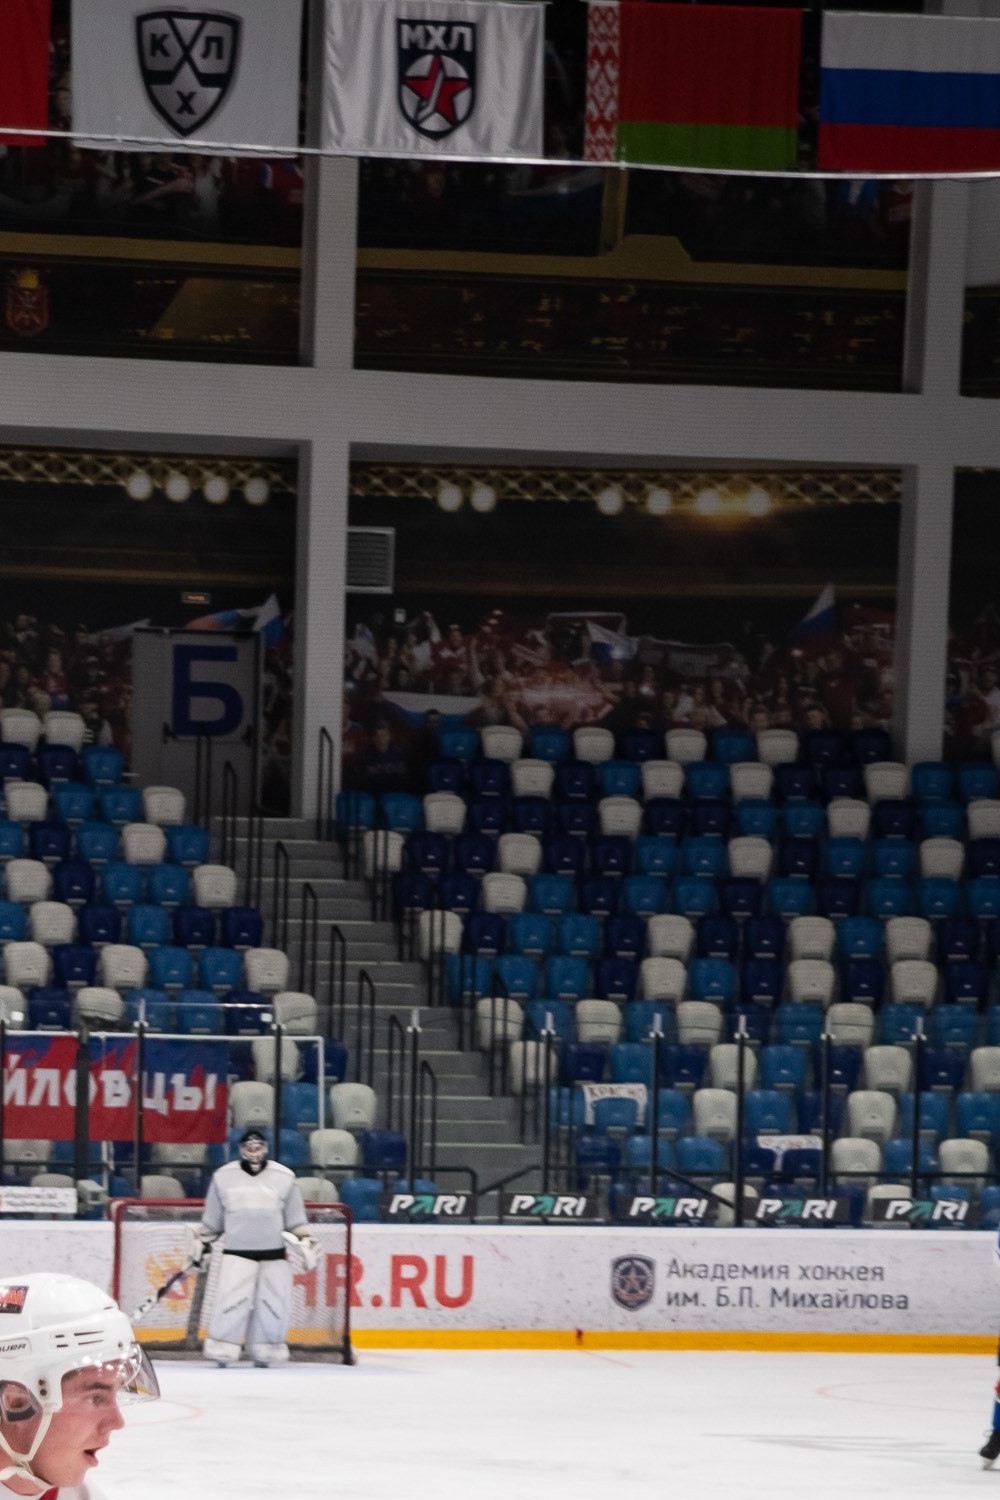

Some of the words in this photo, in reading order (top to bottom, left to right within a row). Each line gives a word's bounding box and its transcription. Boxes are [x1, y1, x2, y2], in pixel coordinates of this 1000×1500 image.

[400, 24, 473, 52] МХЛ
[173, 645, 244, 736] Б
[389, 1194, 467, 1215] PARI
[509, 1195, 587, 1216] PARI
[630, 1197, 708, 1218] PARI
[756, 1199, 838, 1219] PARI
[885, 1200, 969, 1221] PARI
[666, 1259, 790, 1281] Академия
[799, 1264, 885, 1281] хоккея
[666, 1291, 706, 1308] им.
[716, 1286, 760, 1308] Б.П.
[770, 1287, 910, 1311] Михайлова
